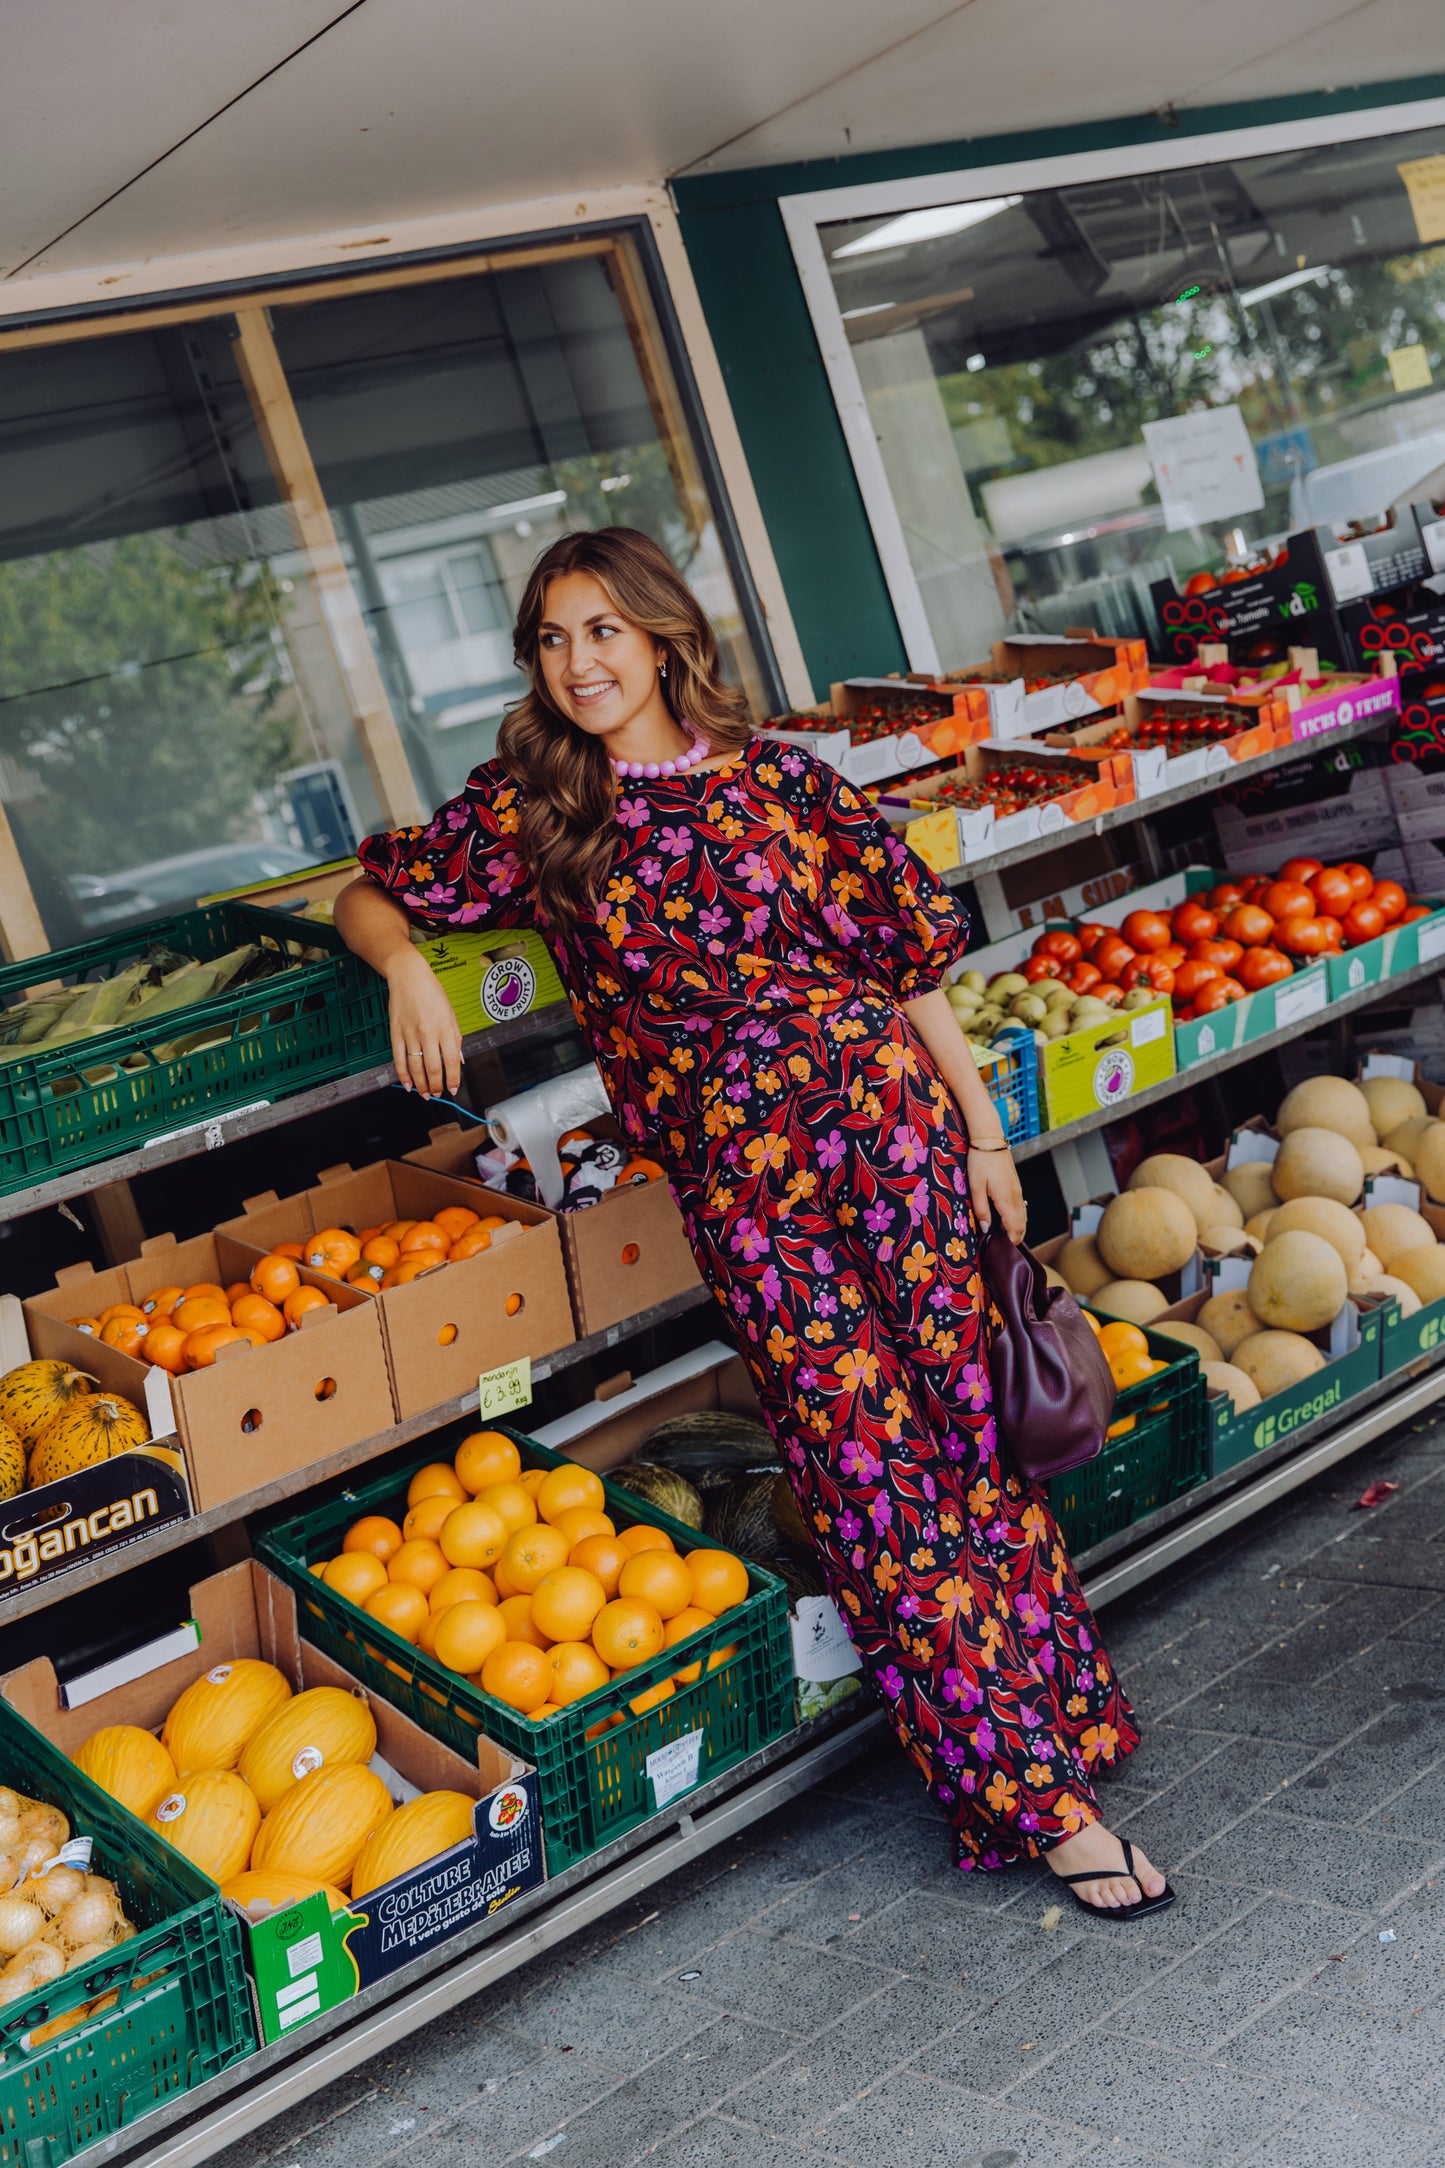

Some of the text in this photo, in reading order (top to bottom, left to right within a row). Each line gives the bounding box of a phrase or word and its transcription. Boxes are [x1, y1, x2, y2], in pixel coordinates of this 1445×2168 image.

[486, 980, 531, 1018] STONE FRUITS
[490, 960, 524, 982] GROW
[1277, 1378, 1341, 1433] Gregal
[378, 1857, 471, 1923] COLTURE
[381, 1847, 531, 1953] MEDITERRANEE
[418, 1925, 441, 1942] vero
[442, 1907, 471, 1930] gusto
[486, 1884, 506, 1901] sole
